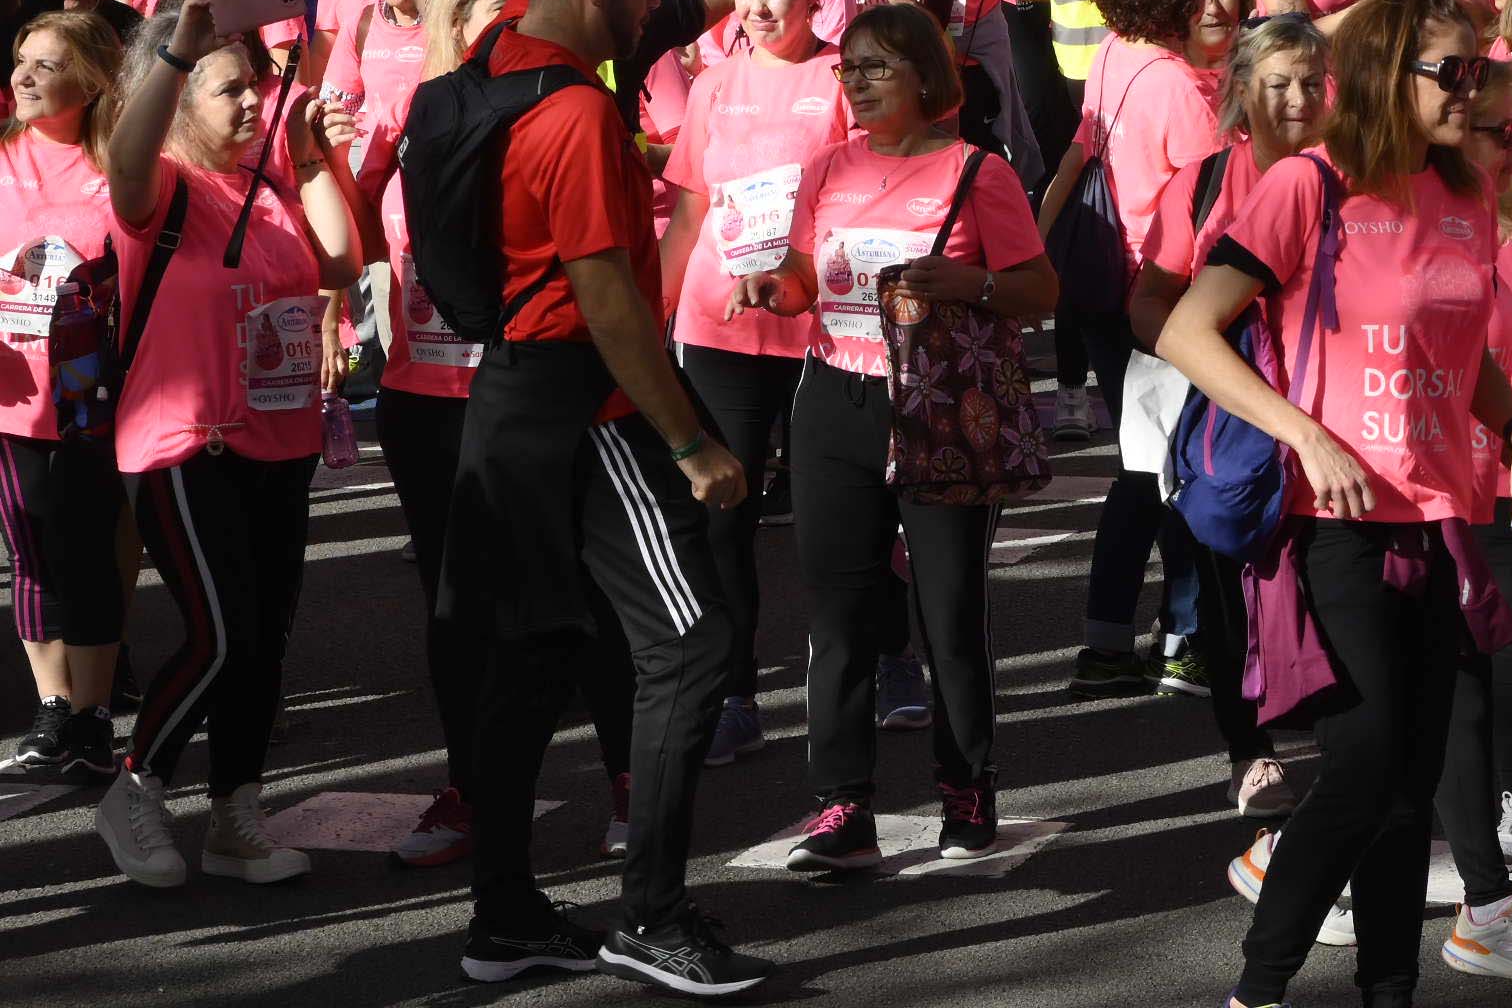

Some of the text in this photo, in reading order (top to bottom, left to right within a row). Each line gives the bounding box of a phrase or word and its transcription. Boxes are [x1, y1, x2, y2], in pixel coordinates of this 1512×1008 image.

[1345, 220, 1404, 234] OYSHO
[856, 248, 896, 259] ASTURIANA
[861, 291, 880, 302] 262
[1, 303, 53, 315] CARRERA DE LA
[833, 303, 864, 312] CARRERA
[864, 305, 873, 313] DE
[830, 318, 863, 329] OYSHO
[1361, 324, 1406, 355] TU
[286, 341, 312, 358] 016
[1361, 409, 1444, 442] SUMA
